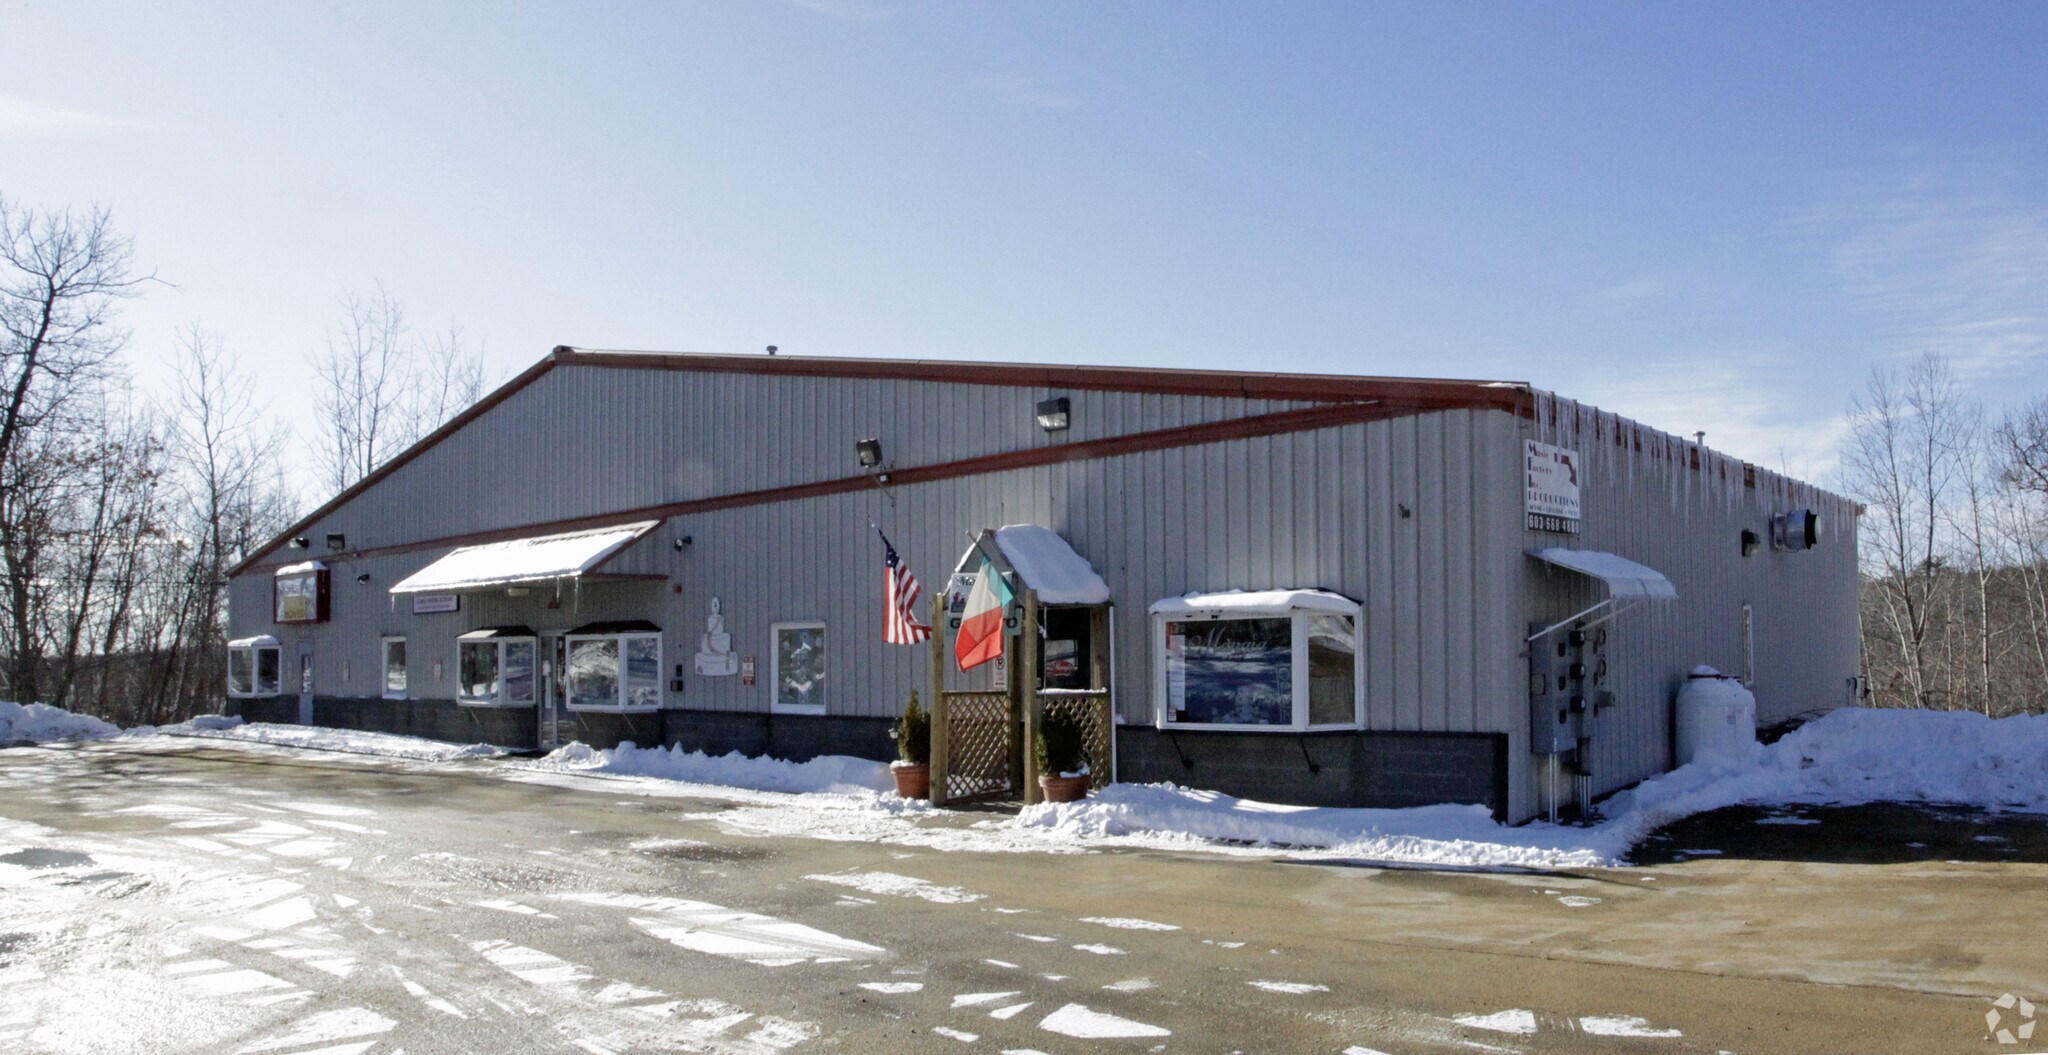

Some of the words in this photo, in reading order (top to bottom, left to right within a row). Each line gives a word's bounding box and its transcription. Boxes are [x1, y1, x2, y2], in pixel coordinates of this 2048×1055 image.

[1528, 443, 1549, 458] Music
[1528, 457, 1552, 474] Factory
[1529, 515, 1543, 529] 603
